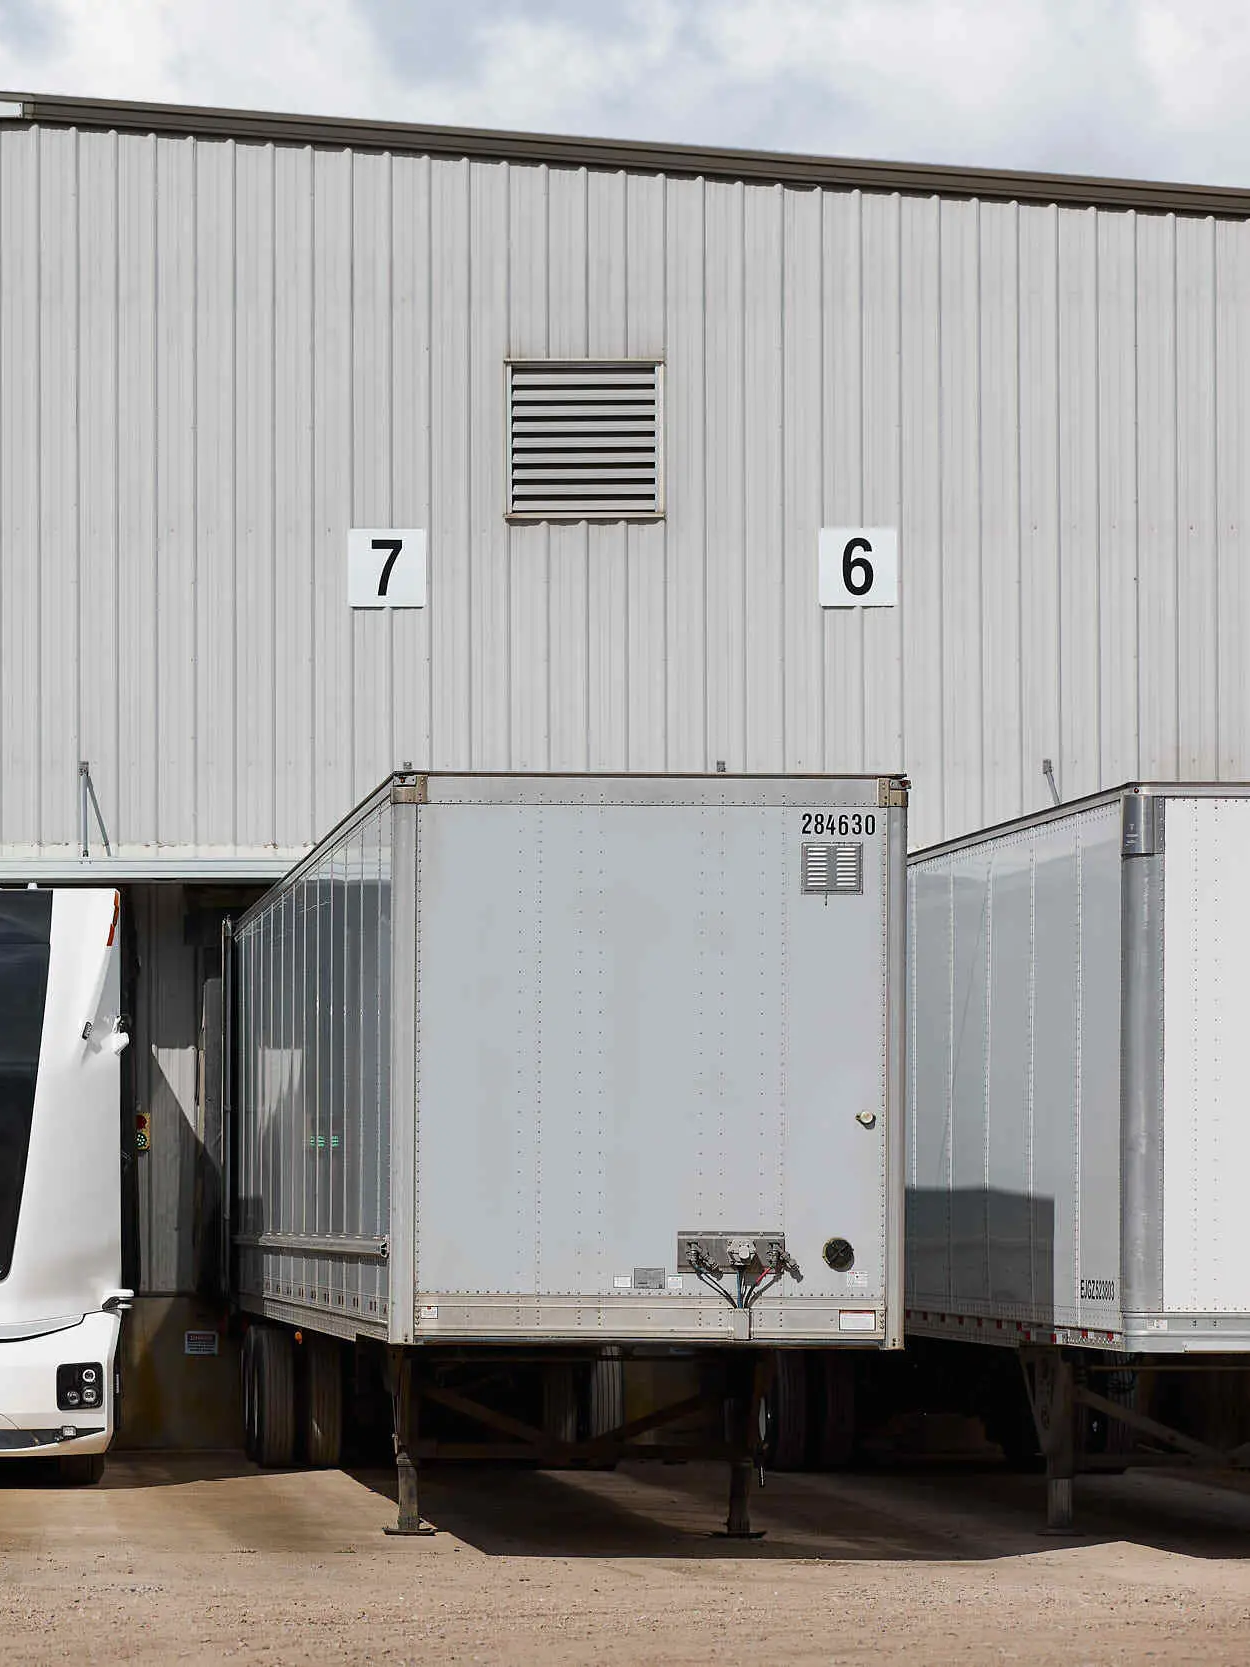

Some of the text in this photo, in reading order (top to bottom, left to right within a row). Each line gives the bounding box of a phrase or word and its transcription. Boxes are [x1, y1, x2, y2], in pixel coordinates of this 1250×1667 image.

[371, 539, 403, 596] 7
[842, 537, 874, 596] 6
[801, 813, 876, 836] 284630
